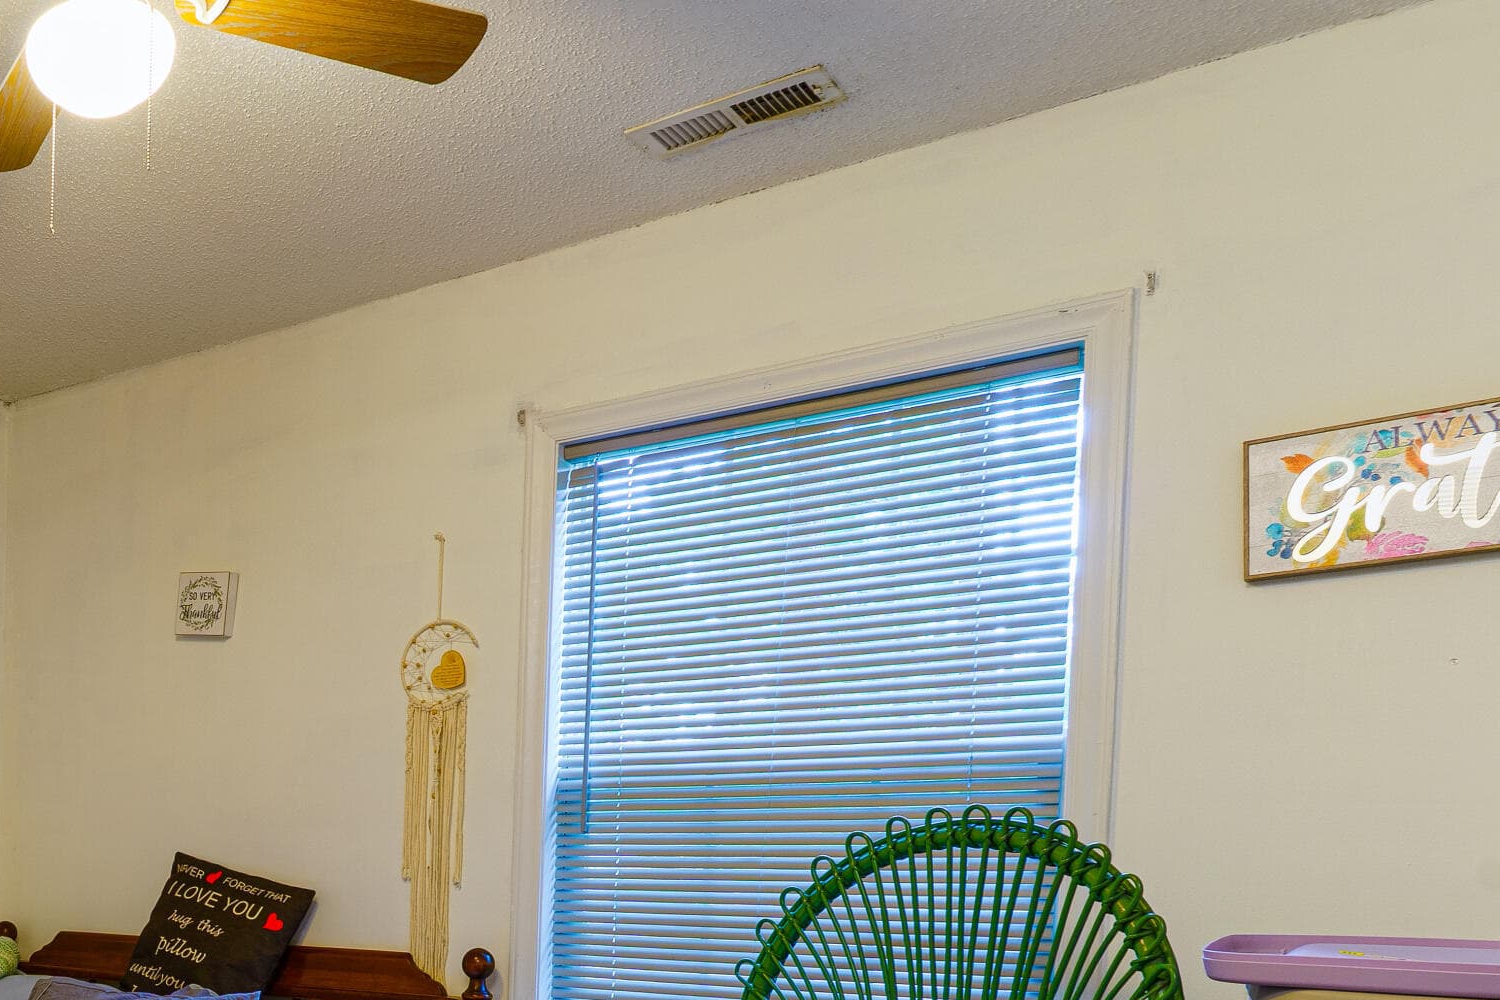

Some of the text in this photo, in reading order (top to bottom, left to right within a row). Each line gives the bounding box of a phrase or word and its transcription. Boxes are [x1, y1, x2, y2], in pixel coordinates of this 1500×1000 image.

[199, 591, 216, 601] VERY
[167, 880, 265, 920] I LOVE YOU
[222, 877, 264, 896] FORGET
[264, 890, 292, 904] THAT
[167, 909, 225, 938] hug this
[155, 935, 208, 965] pillow
[129, 962, 162, 981] until
[155, 973, 186, 989] you
